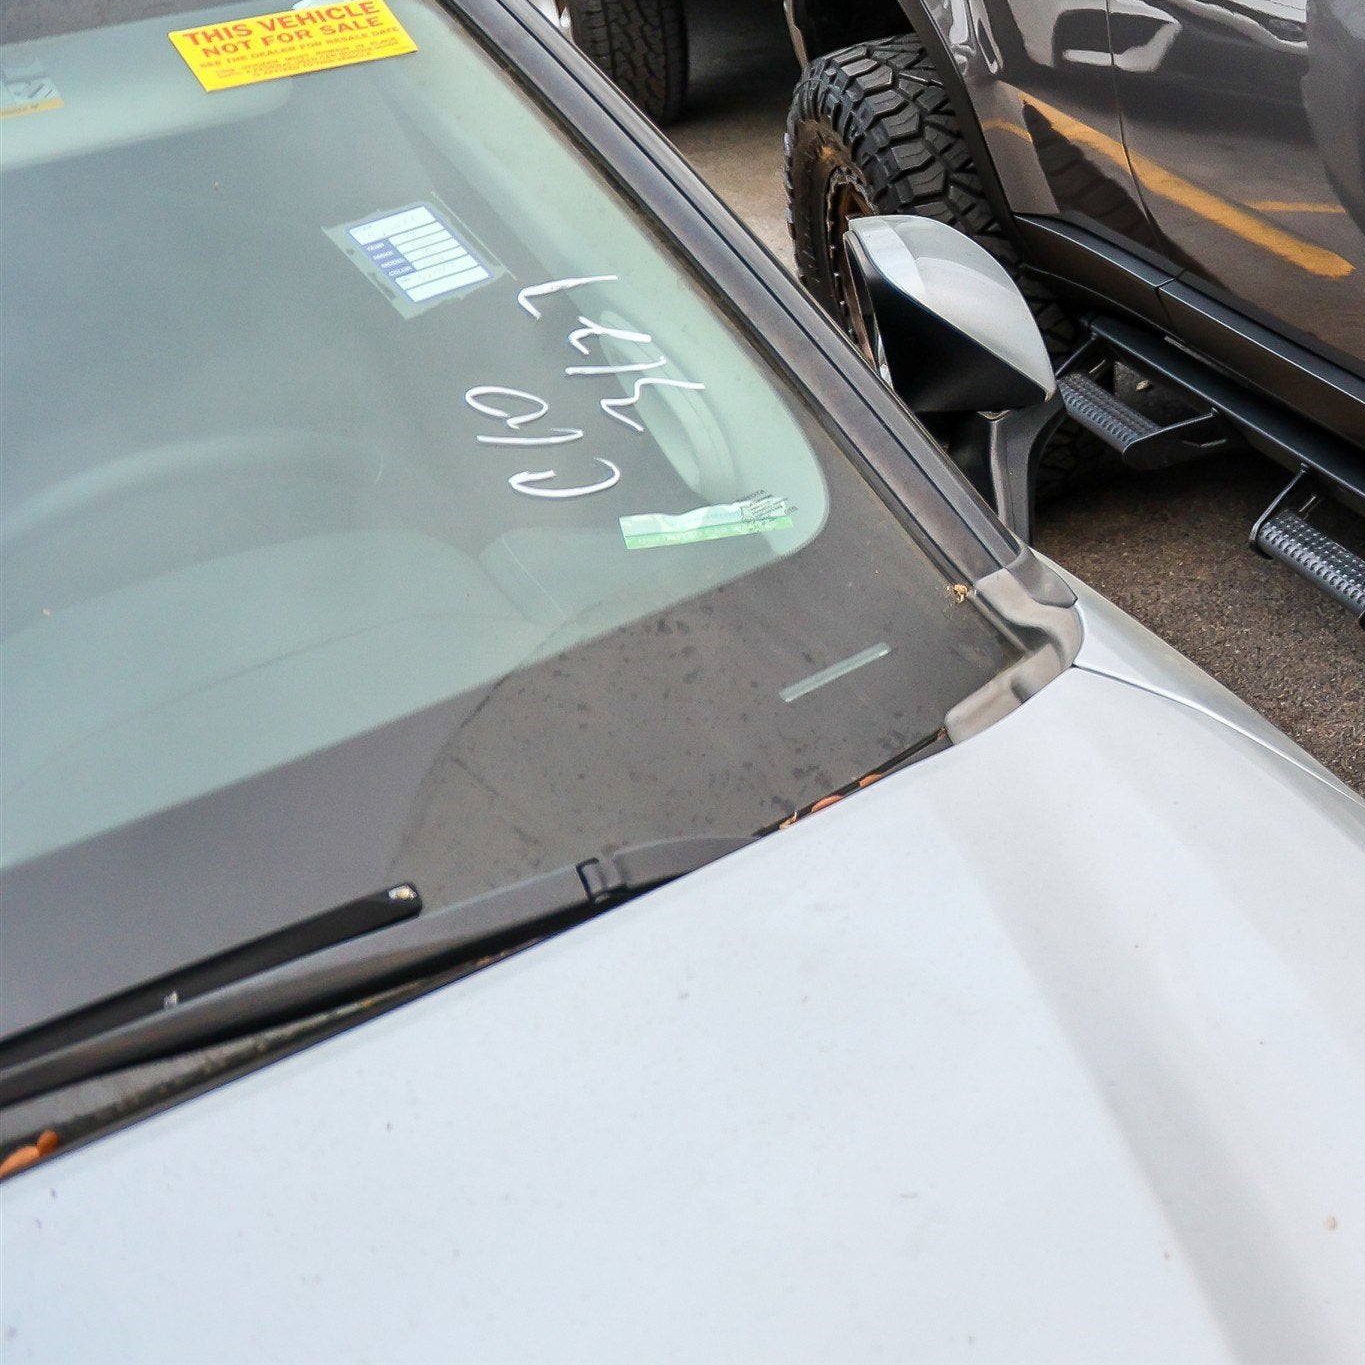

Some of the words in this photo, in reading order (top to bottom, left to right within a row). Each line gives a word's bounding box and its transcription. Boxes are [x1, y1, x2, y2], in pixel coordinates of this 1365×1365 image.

[183, 24, 253, 46] THIS
[257, 1, 381, 32] VEHICLE
[202, 41, 251, 58] NOT
[261, 29, 313, 47] FOR
[319, 16, 383, 35] SALE
[226, 55, 248, 64] THE
[251, 46, 297, 59] DEALER
[300, 40, 322, 50] FOR
[326, 32, 370, 45] RESALE
[371, 26, 400, 37] DATE
